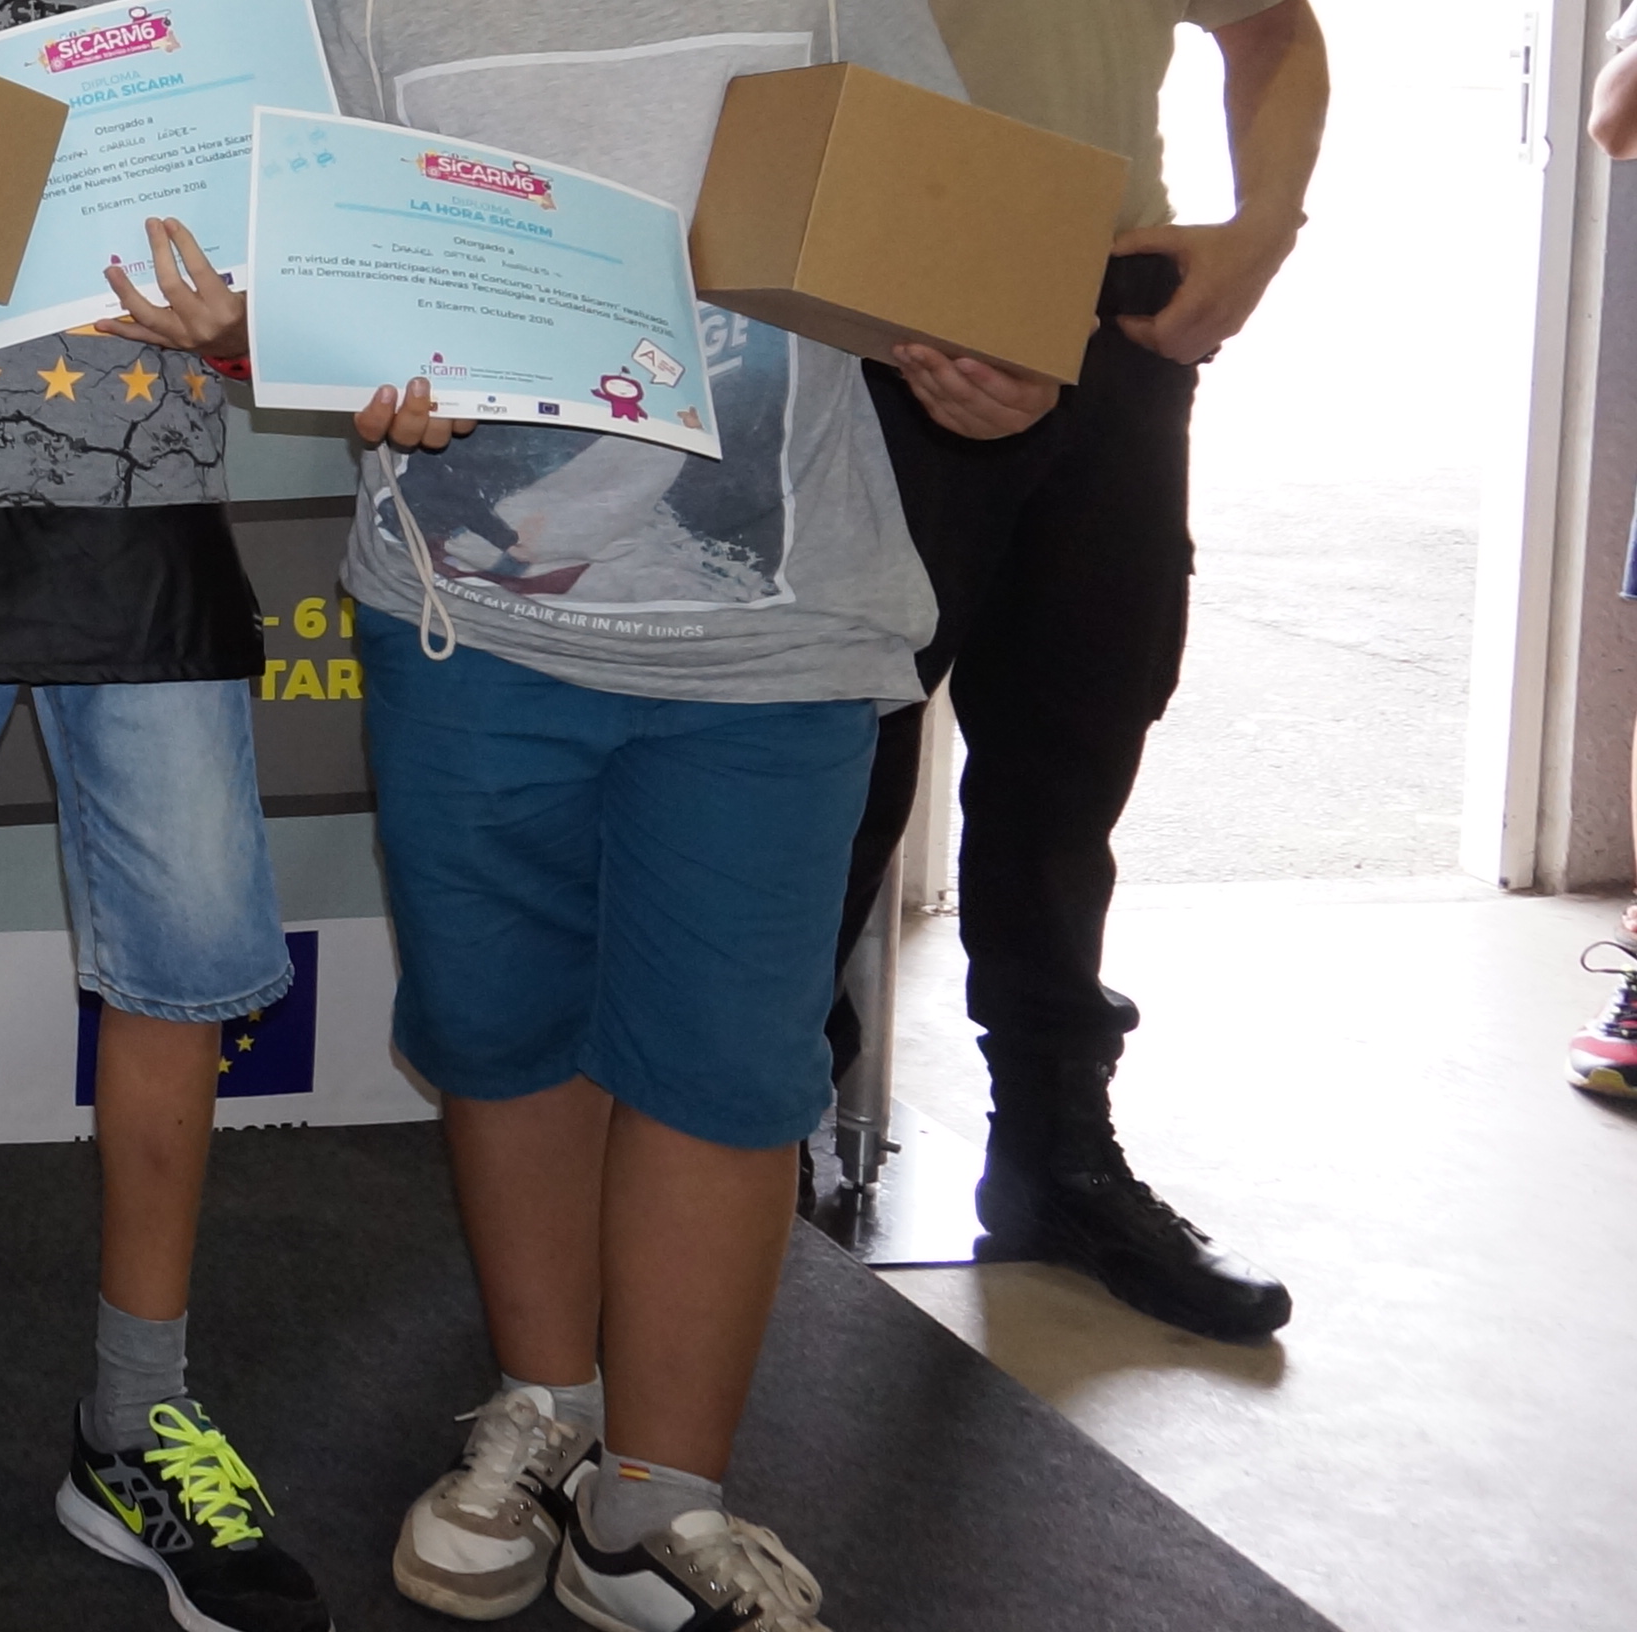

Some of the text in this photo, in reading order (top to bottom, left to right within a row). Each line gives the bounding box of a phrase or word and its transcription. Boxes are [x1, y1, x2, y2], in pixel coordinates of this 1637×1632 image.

[68, 72, 185, 108] HORA SICARM
[81, 70, 141, 92] DIPLOMA
[94, 116, 154, 136] Otorgado a
[103, 162, 117, 172] en
[118, 159, 129, 169] el
[129, 148, 179, 167] Concurso
[197, 138, 223, 152] Hora
[68, 158, 194, 194] de Nuevas Tecnologías a
[80, 179, 207, 216] En Octubre 2016
[451, 195, 512, 216] DIPLOMA
[410, 199, 553, 238] LA HORA SICARM
[453, 236, 506, 254] Otorgado
[280, 267, 295, 276] en
[297, 266, 314, 277] las
[316, 267, 409, 283] Demostraciones
[411, 273, 425, 284] de
[428, 276, 469, 290] Nuevas
[547, 296, 611, 319] Ciudadanos
[288, 254, 302, 263] en
[304, 253, 338, 265] virtud
[341, 256, 356, 266] de
[358, 259, 371, 268] su
[374, 259, 450, 276] participación
[452, 269, 467, 278] en
[469, 270, 479, 279] el
[481, 273, 533, 290] Concurso
[553, 288, 579, 301] Hora
[417, 298, 555, 326] En Octubre 2016
[420, 362, 468, 377] sicarm
[513, 603, 555, 622] HAIR
[557, 610, 588, 627] AIR
[592, 617, 610, 631] IN
[615, 621, 643, 635] MY
[647, 624, 705, 638] LUNGS
